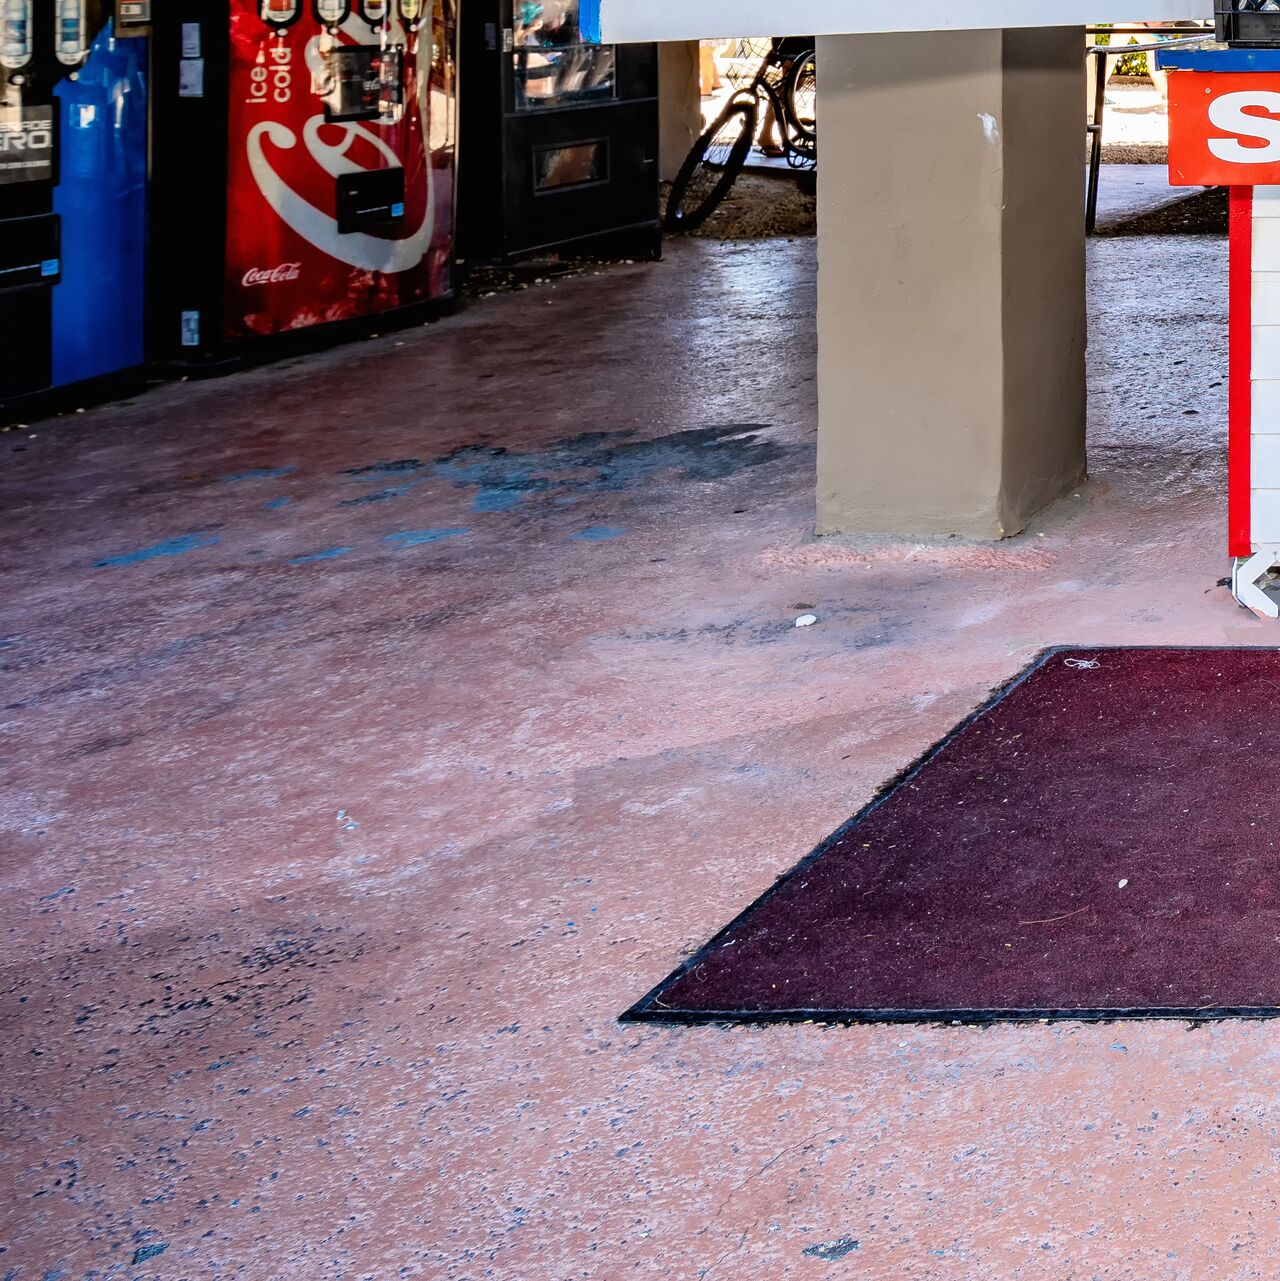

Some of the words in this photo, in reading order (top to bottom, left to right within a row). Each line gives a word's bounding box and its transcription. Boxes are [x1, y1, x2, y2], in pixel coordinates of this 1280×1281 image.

[245, 66, 268, 103] ice
[269, 47, 292, 104] cold
[241, 262, 302, 287] Coca-Cola
